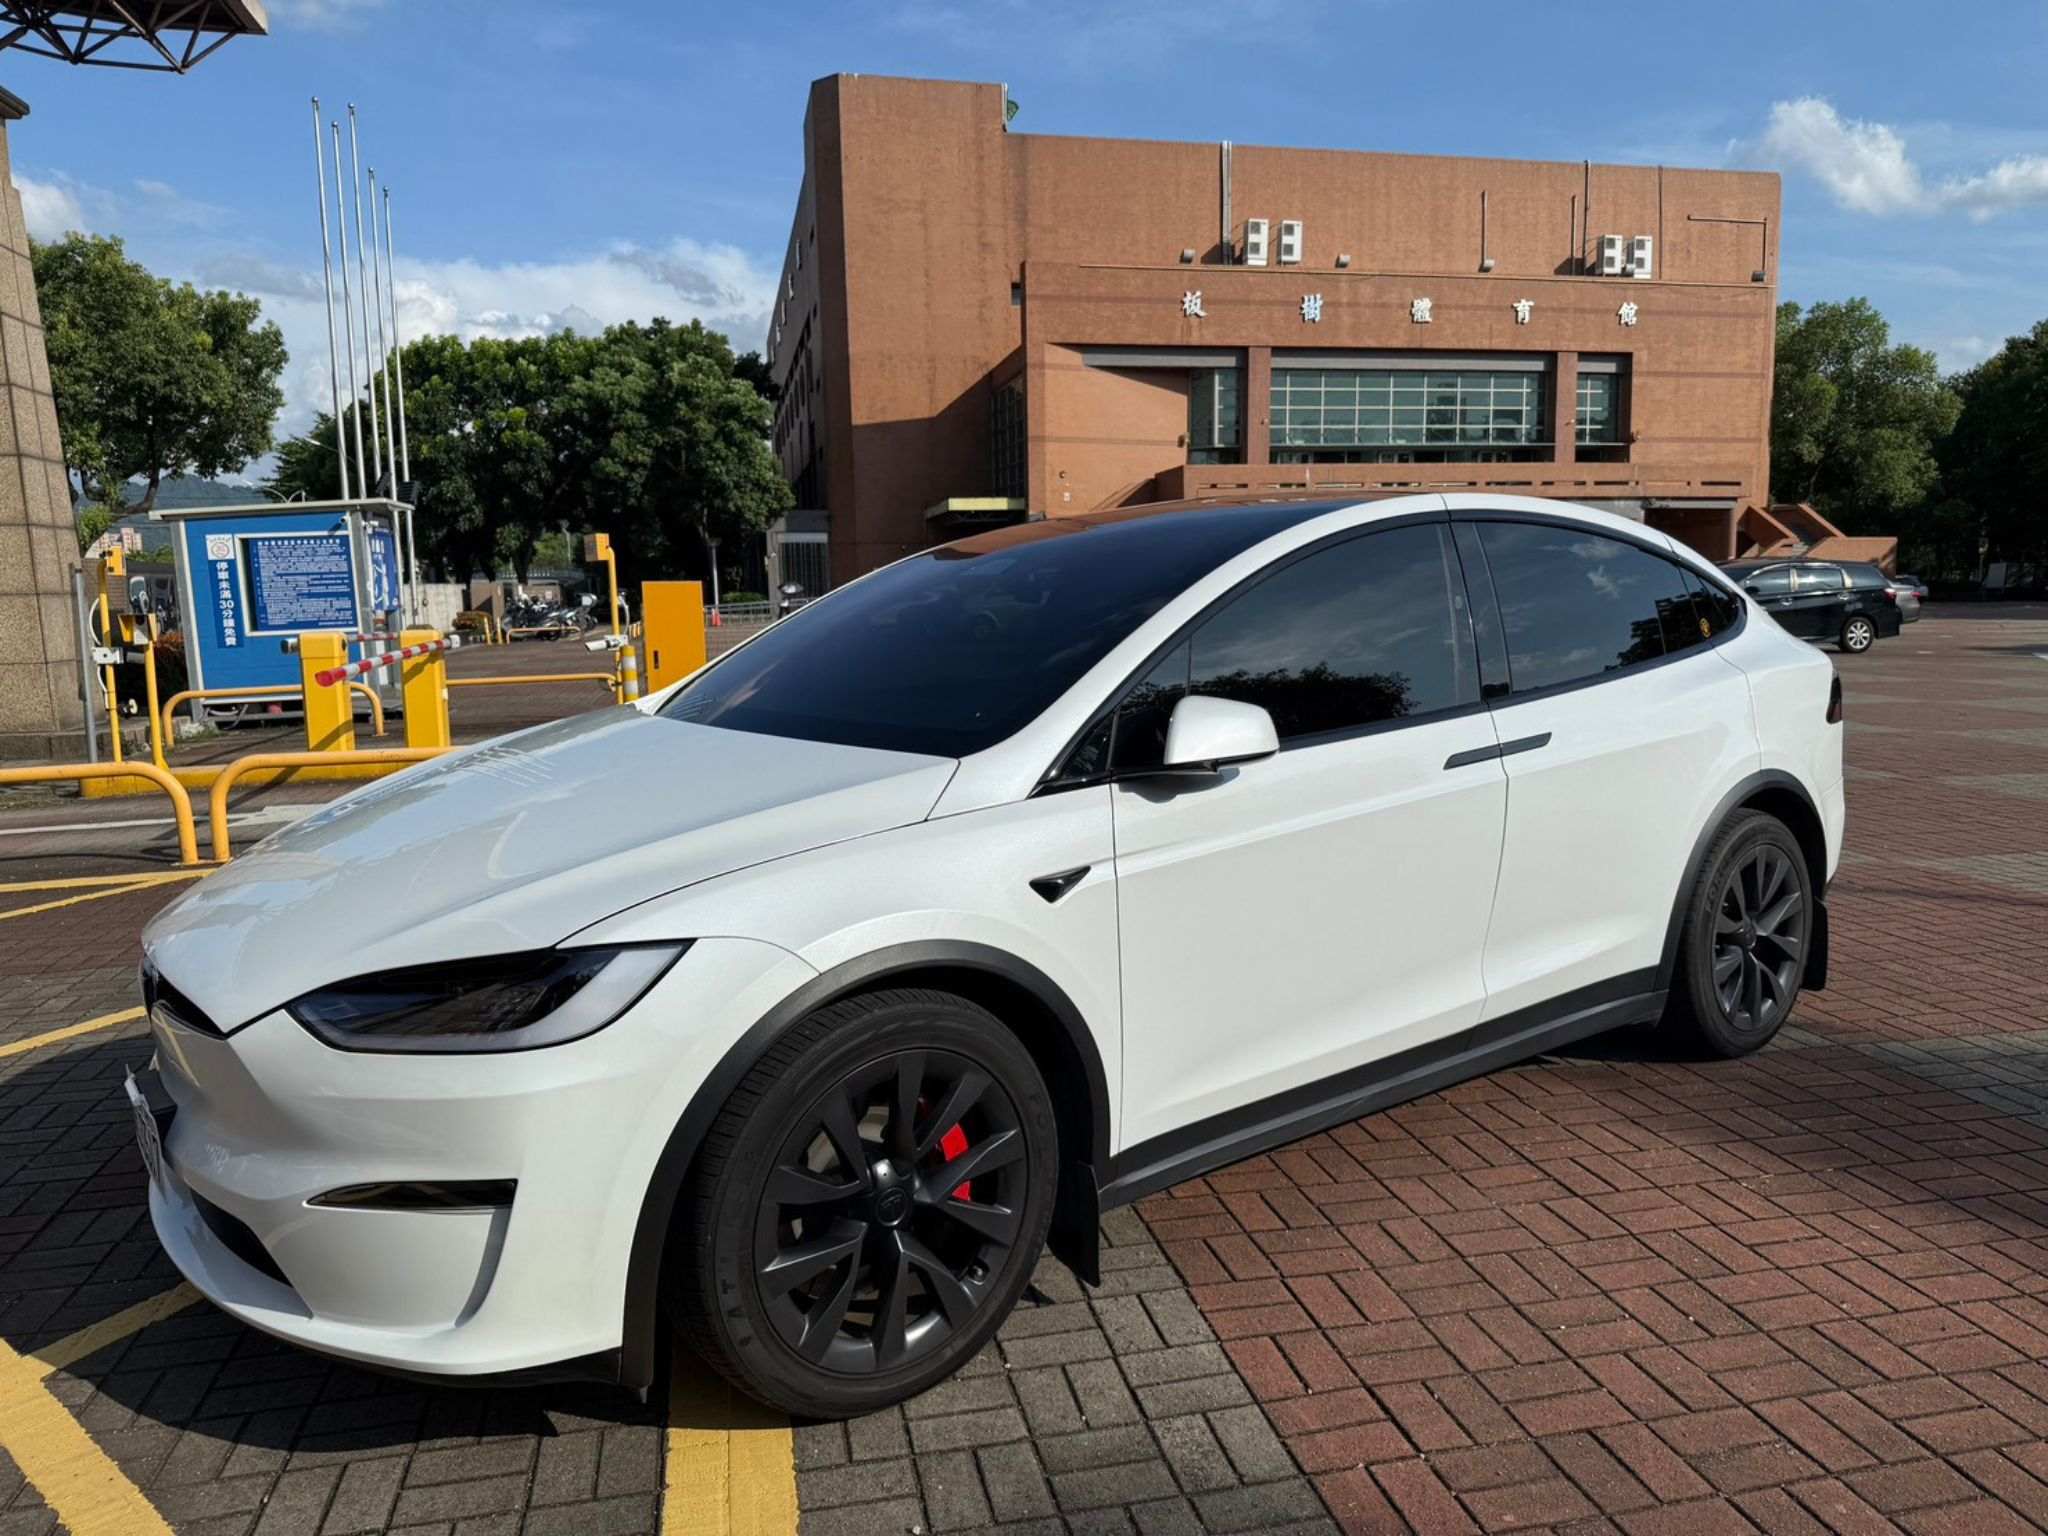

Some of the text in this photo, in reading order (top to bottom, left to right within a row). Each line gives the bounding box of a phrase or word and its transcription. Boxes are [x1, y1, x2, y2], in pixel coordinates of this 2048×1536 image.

[1182, 290, 1638, 326] 板樹體育館
